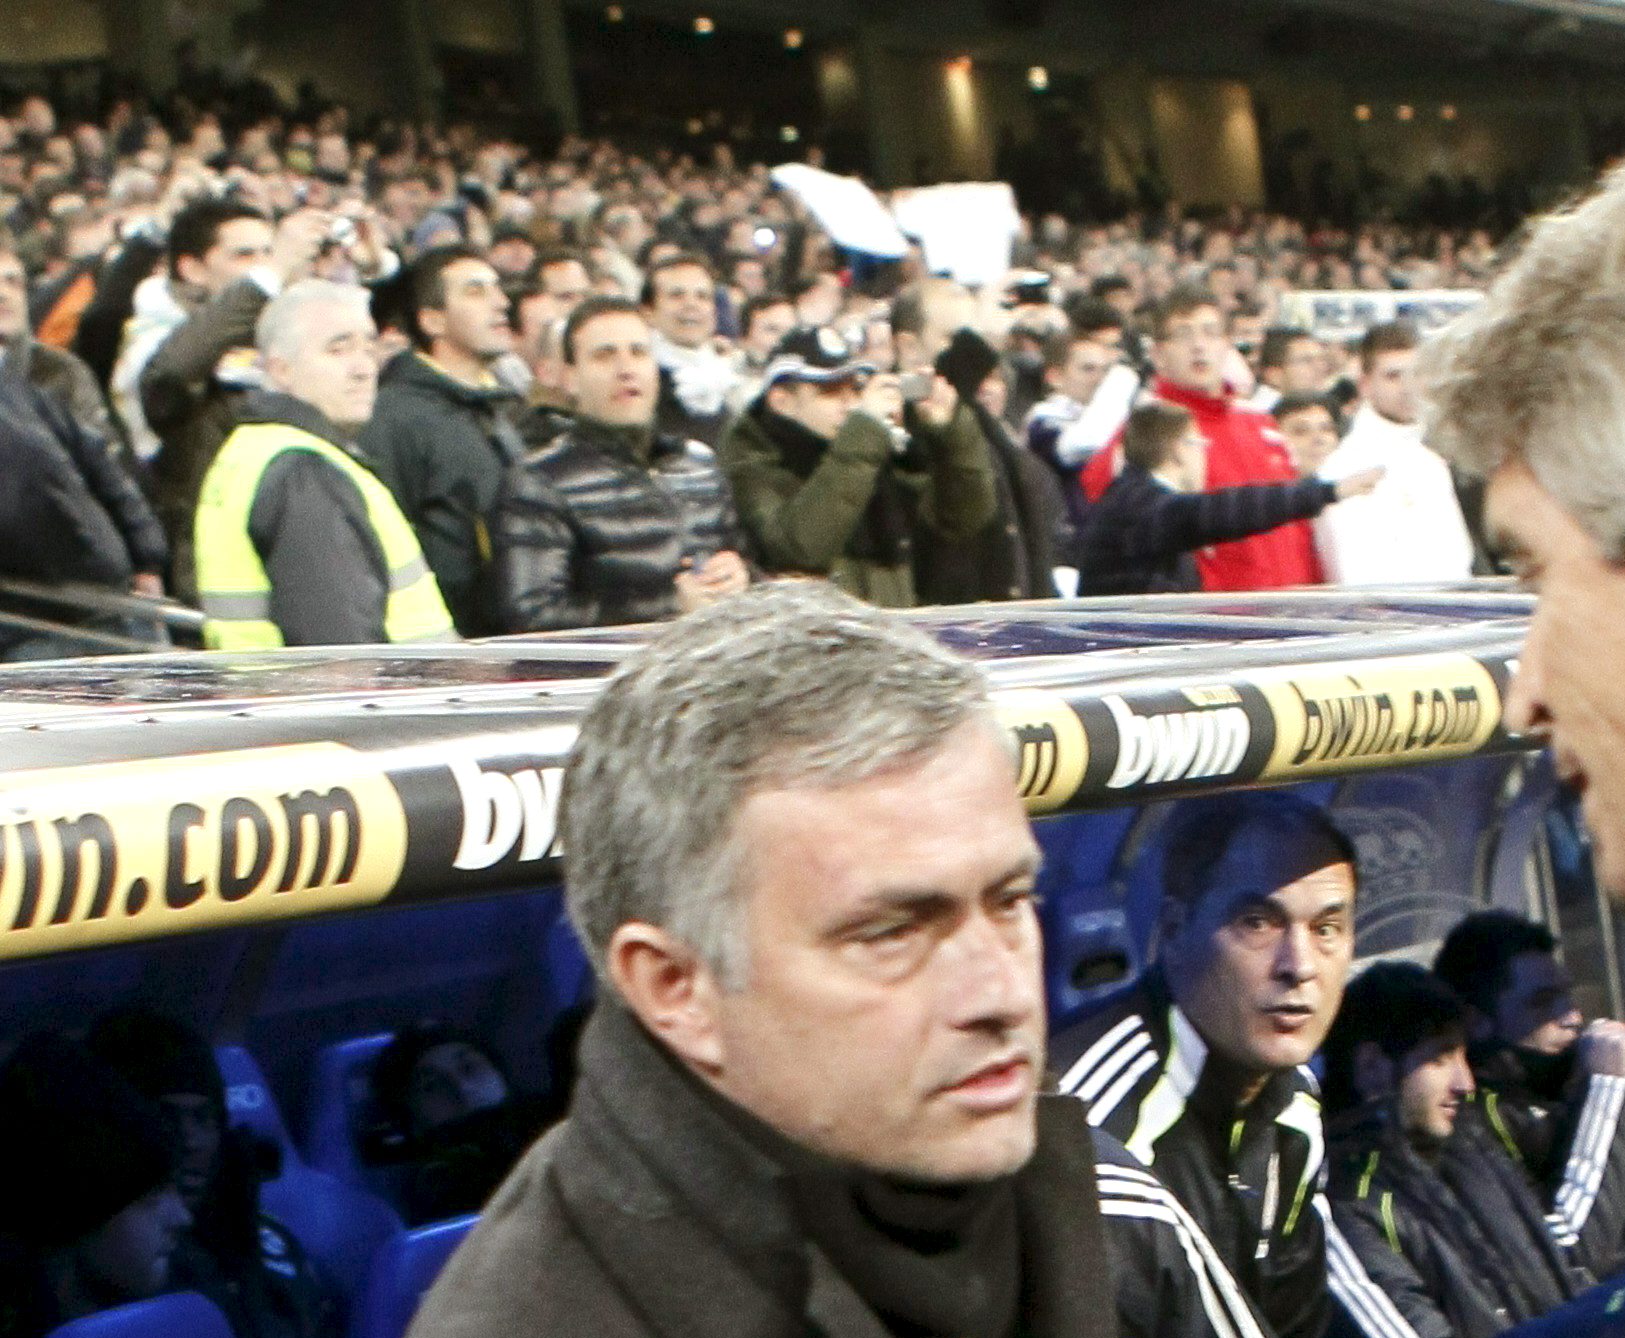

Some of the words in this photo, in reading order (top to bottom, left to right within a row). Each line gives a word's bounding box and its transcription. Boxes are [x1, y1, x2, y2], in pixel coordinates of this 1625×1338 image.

[1101, 693, 1251, 789] bwin
[1287, 674, 1477, 764] bwin.com
[0, 784, 362, 930] in.com
